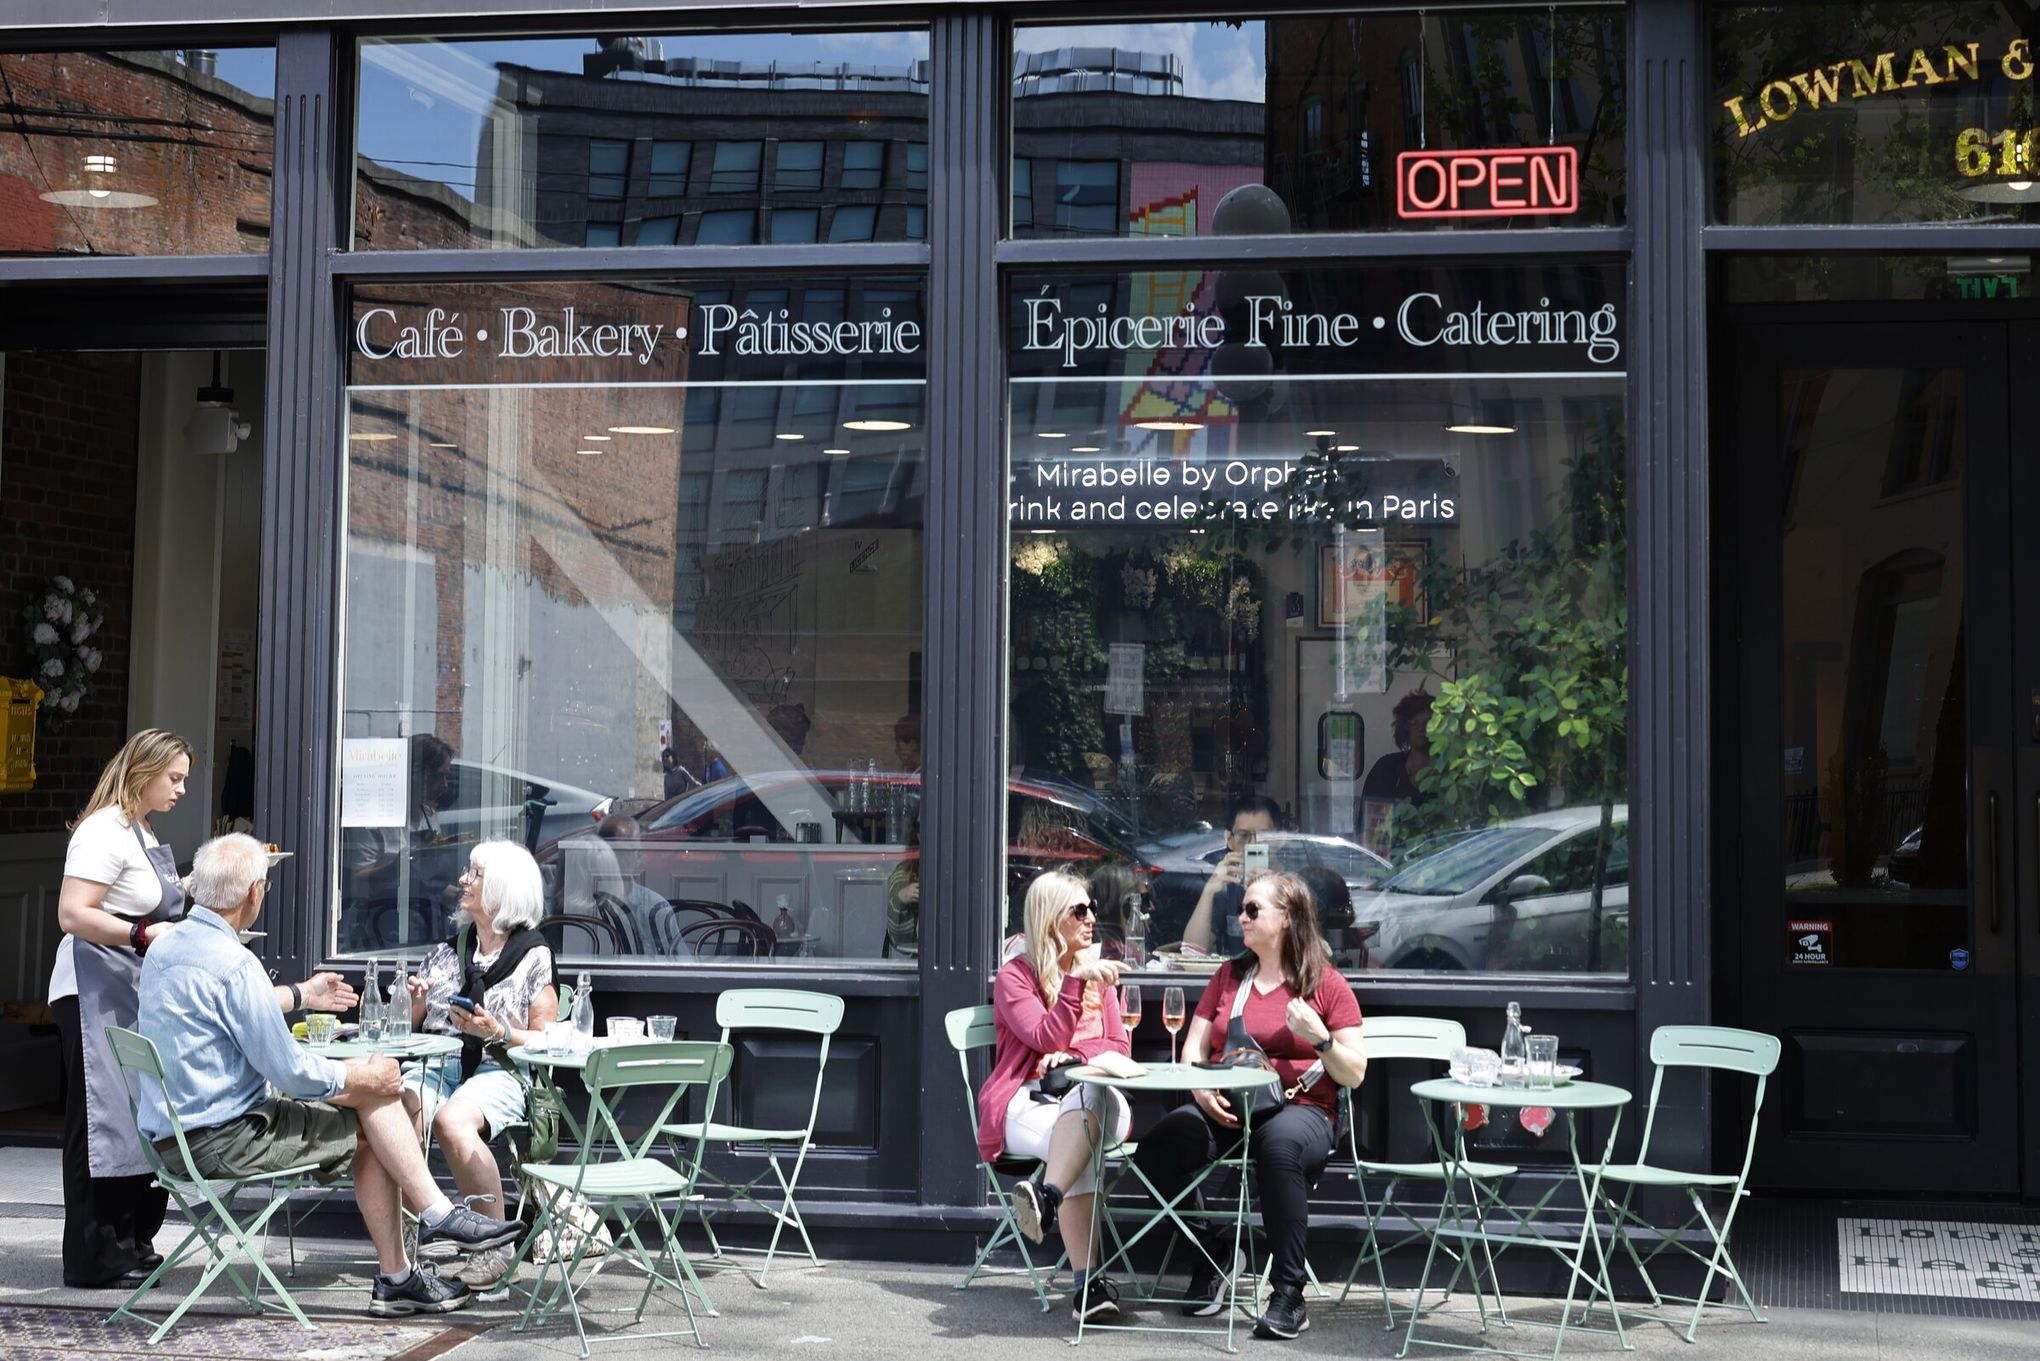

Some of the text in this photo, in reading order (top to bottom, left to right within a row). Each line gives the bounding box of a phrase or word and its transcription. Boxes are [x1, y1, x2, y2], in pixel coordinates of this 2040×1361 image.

[1724, 38, 2035, 138] LOWMAN &
[1408, 155, 1566, 210] OPEN
[356, 303, 920, 365] Café Bakery Pâtisserie
[1023, 284, 1620, 367] Épicerie Fine Catering
[1037, 461, 1171, 488] Mirabelle
[1182, 460, 1217, 491] by
[1070, 494, 1125, 521] and
[1383, 492, 1456, 521] Paris
[1791, 923, 1829, 931] WARNING
